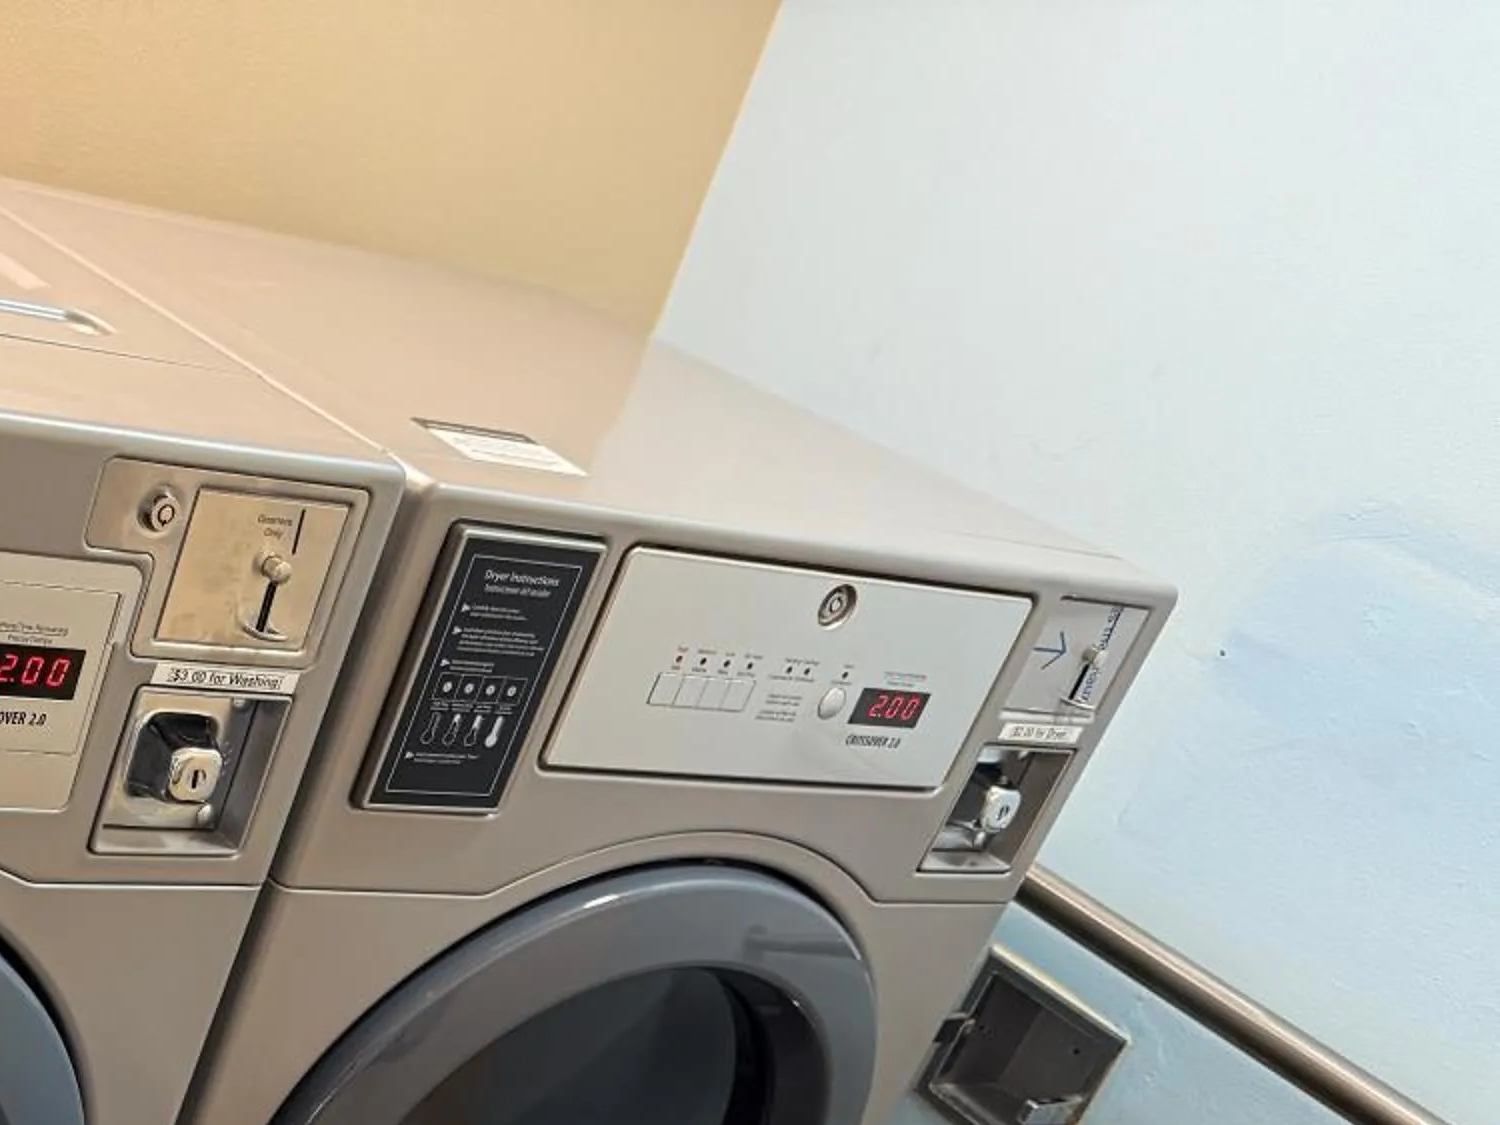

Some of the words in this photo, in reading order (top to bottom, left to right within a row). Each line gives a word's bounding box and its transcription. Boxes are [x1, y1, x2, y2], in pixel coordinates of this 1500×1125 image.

[209, 671, 228, 684] for
[867, 694, 921, 721] 2.00
[28, 713, 48, 727] 2.0
